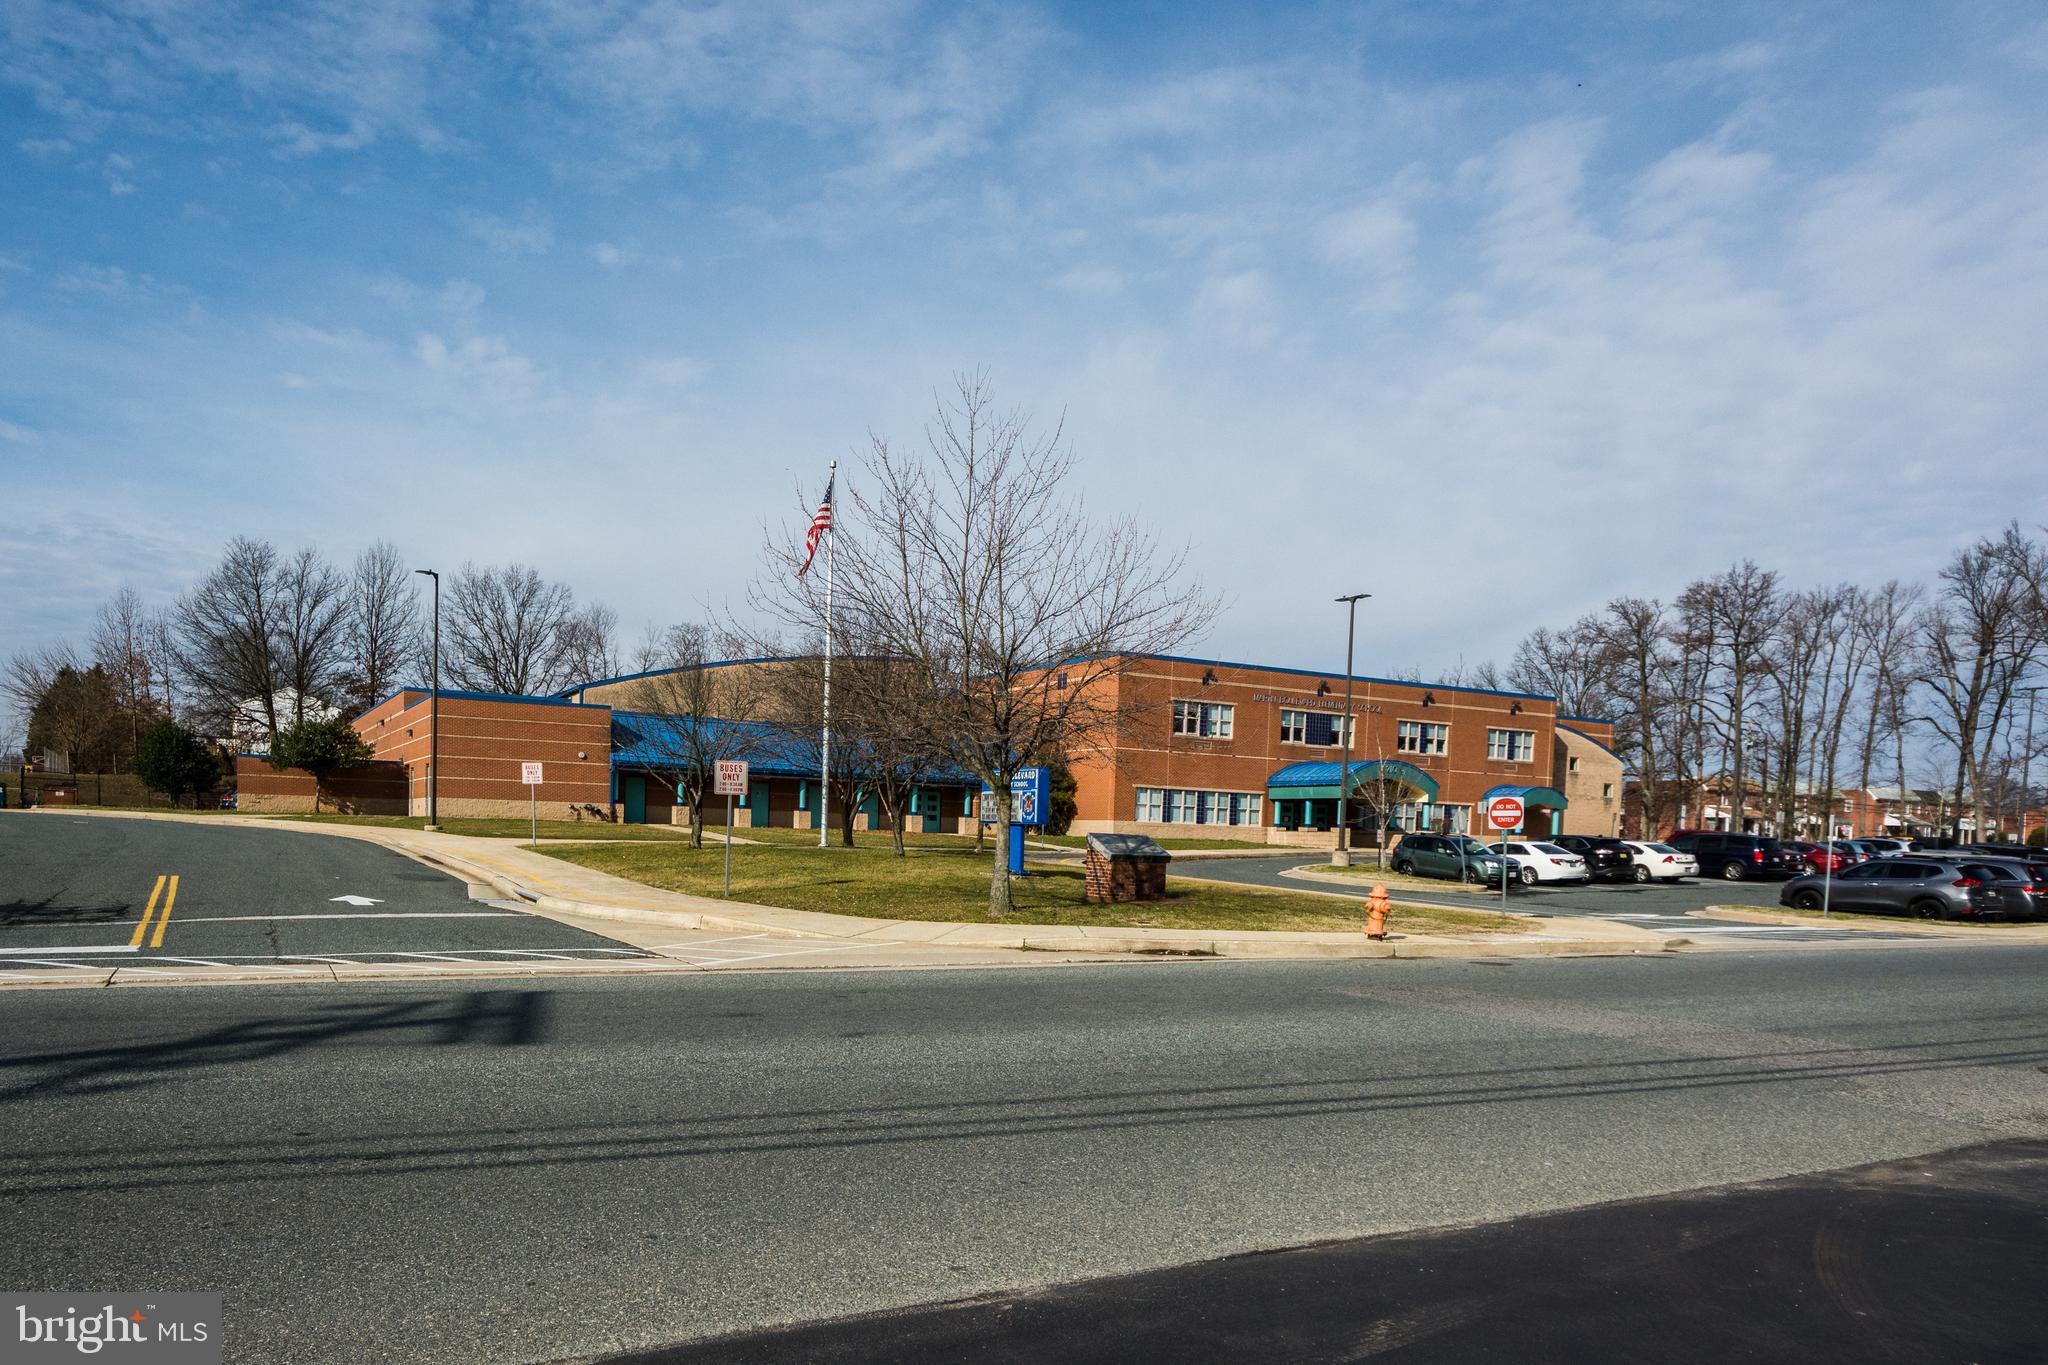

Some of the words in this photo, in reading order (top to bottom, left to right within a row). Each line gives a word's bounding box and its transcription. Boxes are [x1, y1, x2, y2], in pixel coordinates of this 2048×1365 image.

[720, 764, 743, 773] BUSES
[723, 772, 740, 781] ONLY
[1014, 780, 1029, 788] SCHOOL
